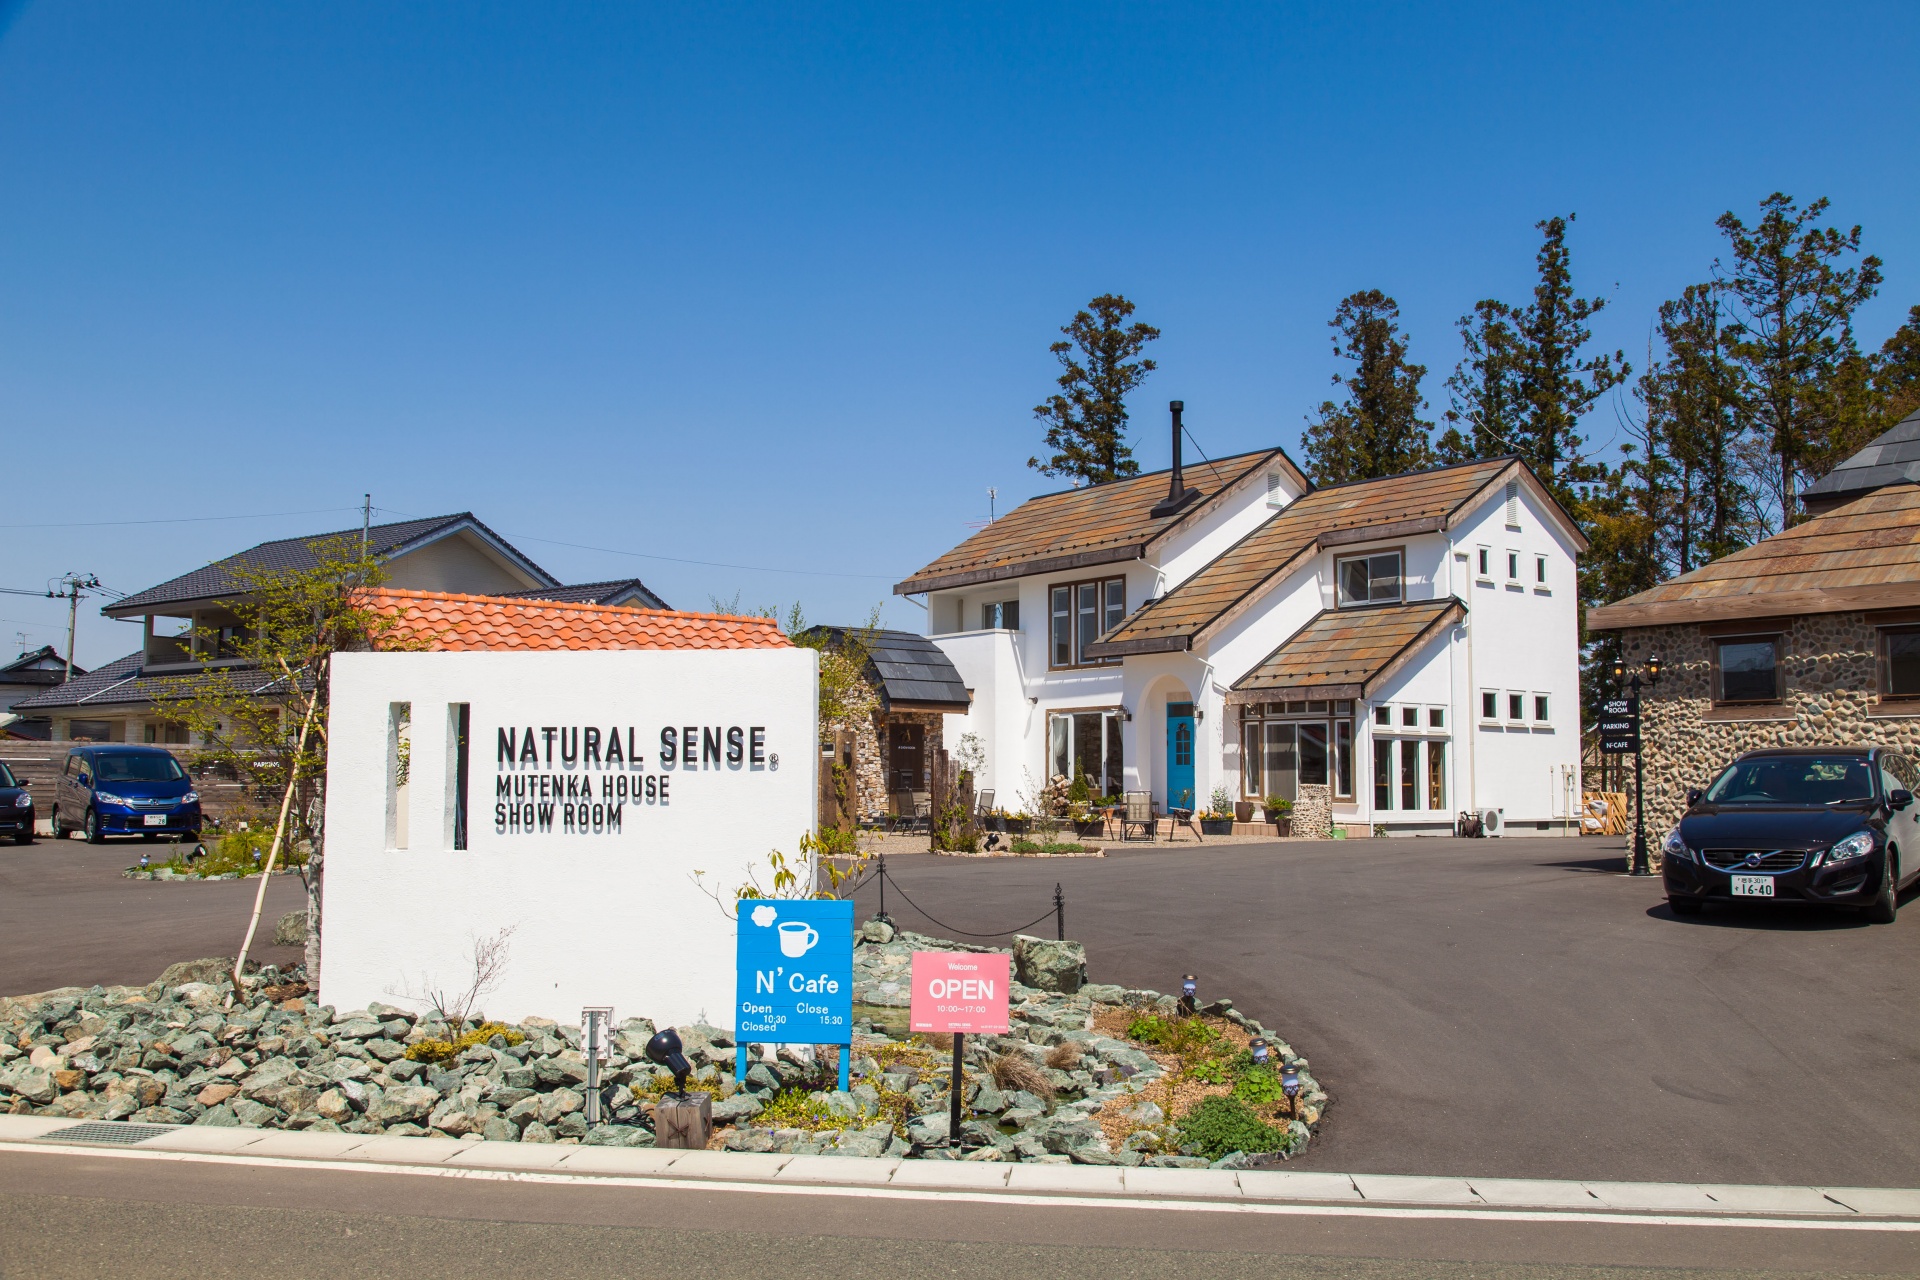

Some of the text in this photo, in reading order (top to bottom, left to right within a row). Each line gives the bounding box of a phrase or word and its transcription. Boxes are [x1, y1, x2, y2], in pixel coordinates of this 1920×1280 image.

[498, 726, 644, 762] NATURAL
[496, 774, 670, 798] MUTENKA HOUSE
[494, 802, 622, 826] SHOW ROOM
[1743, 884, 1772, 895] 16-40
[947, 962, 978, 971] Welcome
[756, 966, 839, 994] N' Cafe
[928, 978, 994, 1000] OPEN
[742, 1001, 829, 1015] Open Close
[741, 1021, 777, 1032] Closed
[763, 1015, 843, 1025] 10:30 15:30
